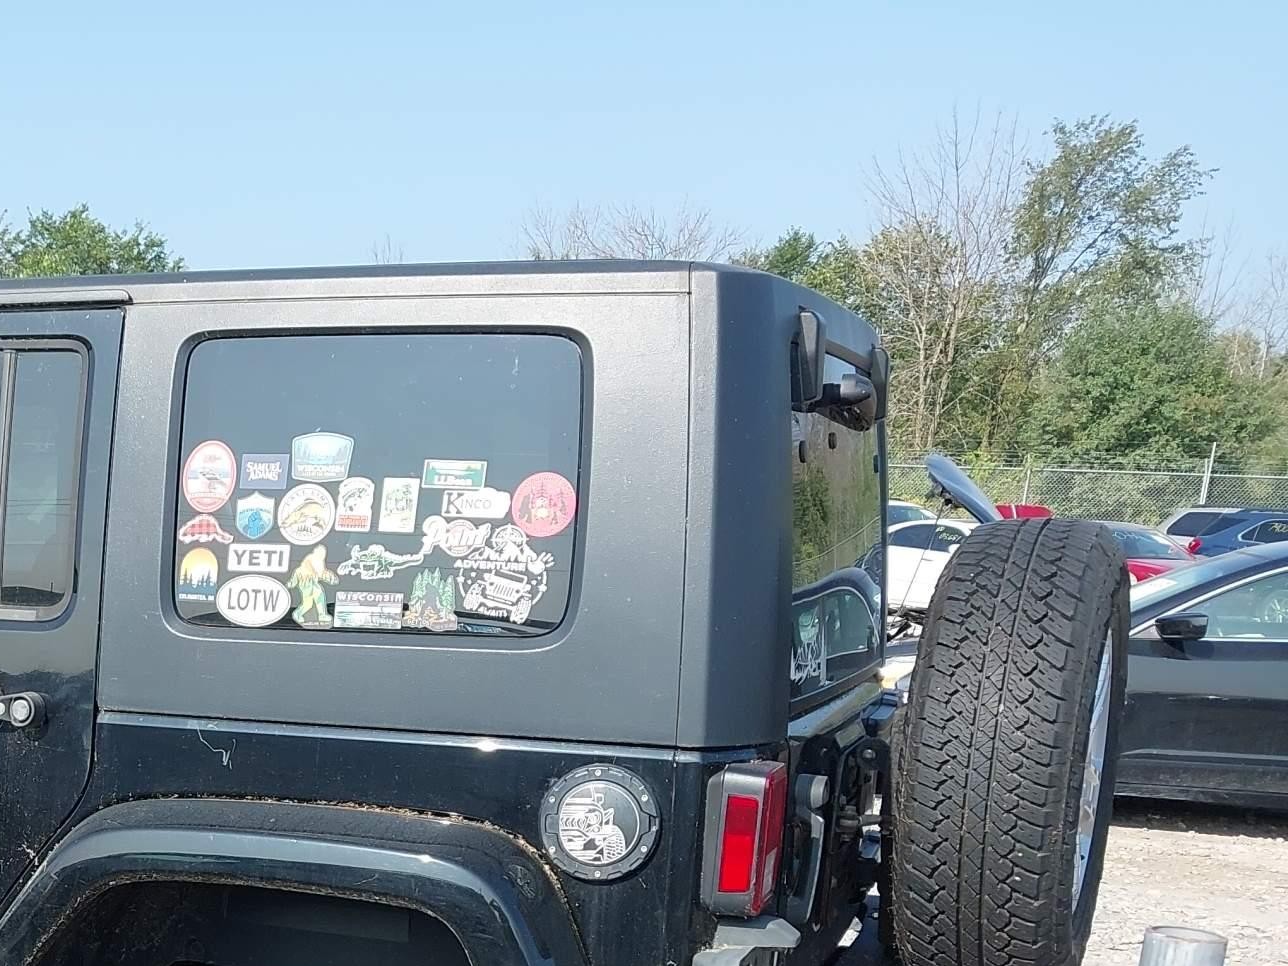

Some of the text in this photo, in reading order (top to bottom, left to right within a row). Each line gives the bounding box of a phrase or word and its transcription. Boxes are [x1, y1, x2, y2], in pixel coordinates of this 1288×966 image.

[246, 461, 283, 473] SAMUEL
[247, 470, 279, 481] ADAMS
[233, 549, 284, 567] YETI
[454, 559, 526, 571] ADVENTURE
[227, 587, 281, 612] LOTW
